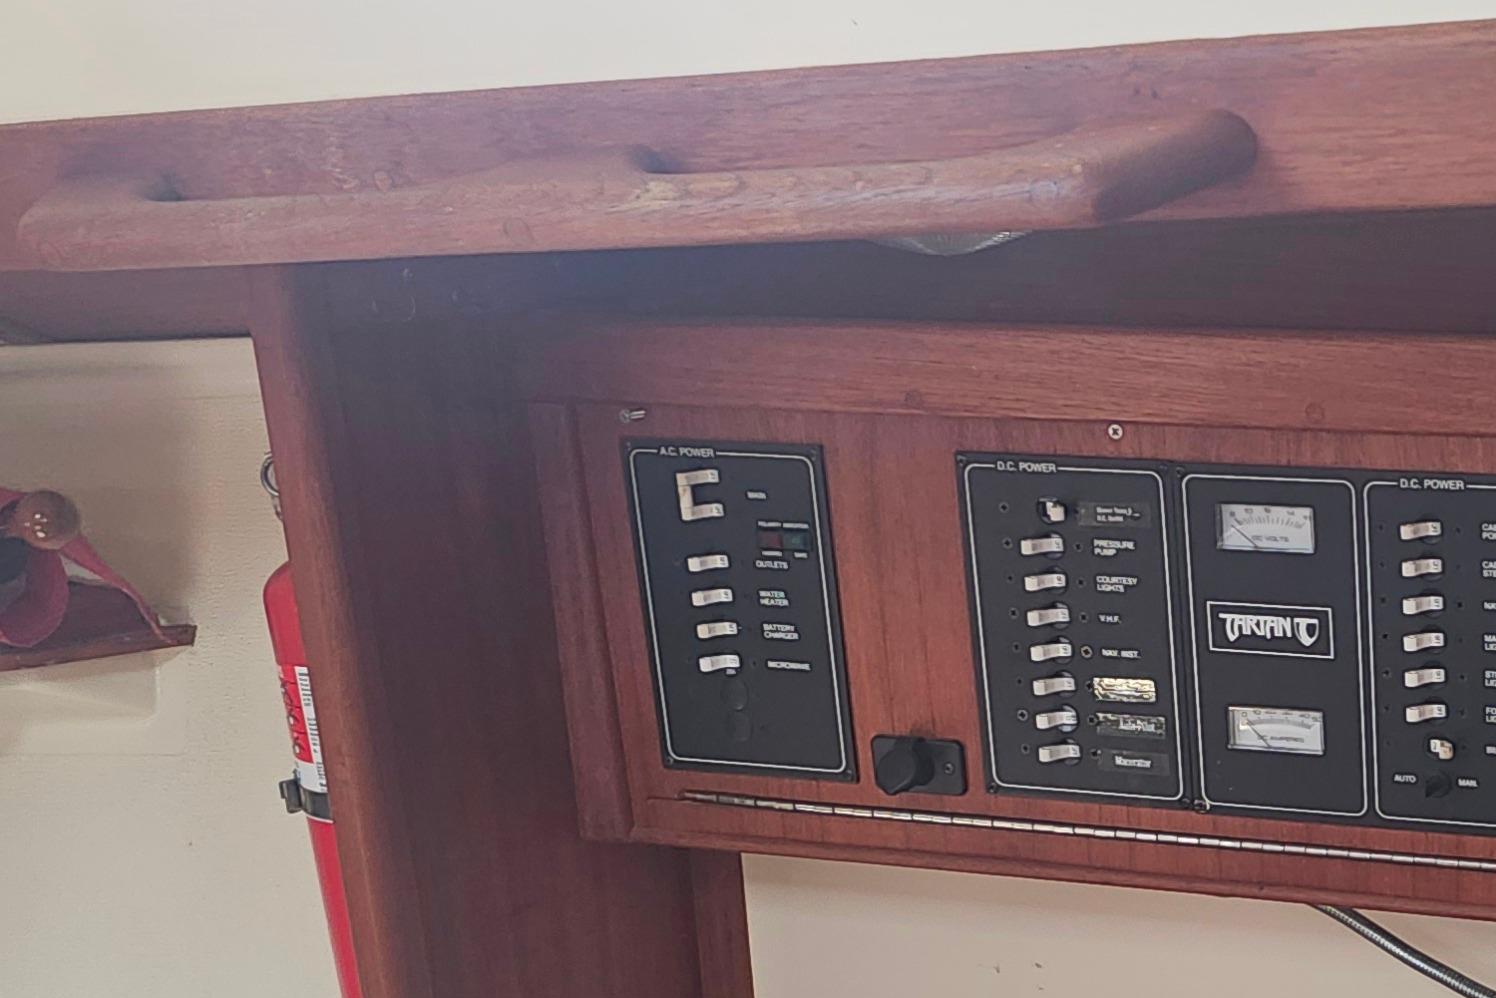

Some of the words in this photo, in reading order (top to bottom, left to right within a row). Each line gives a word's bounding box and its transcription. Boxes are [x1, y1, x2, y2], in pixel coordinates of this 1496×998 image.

[660, 446, 678, 456] A.C.
[679, 448, 714, 458] POWER
[996, 460, 1017, 471] D.C.
[1018, 461, 1056, 473] POWER
[1400, 478, 1422, 488] D.C.
[1424, 479, 1464, 490] POWER
[1093, 538, 1136, 550] PRESSURE
[1094, 548, 1118, 556] PUMP
[756, 560, 788, 570] OUTLETS
[1096, 576, 1138, 585] COURTESY
[1097, 584, 1125, 592] LIGHTS
[763, 624, 795, 632] BATTERY
[1218, 612, 1292, 643] TARTAN
[764, 632, 799, 640] CHARGER
[1394, 774, 1416, 784] AUTO
